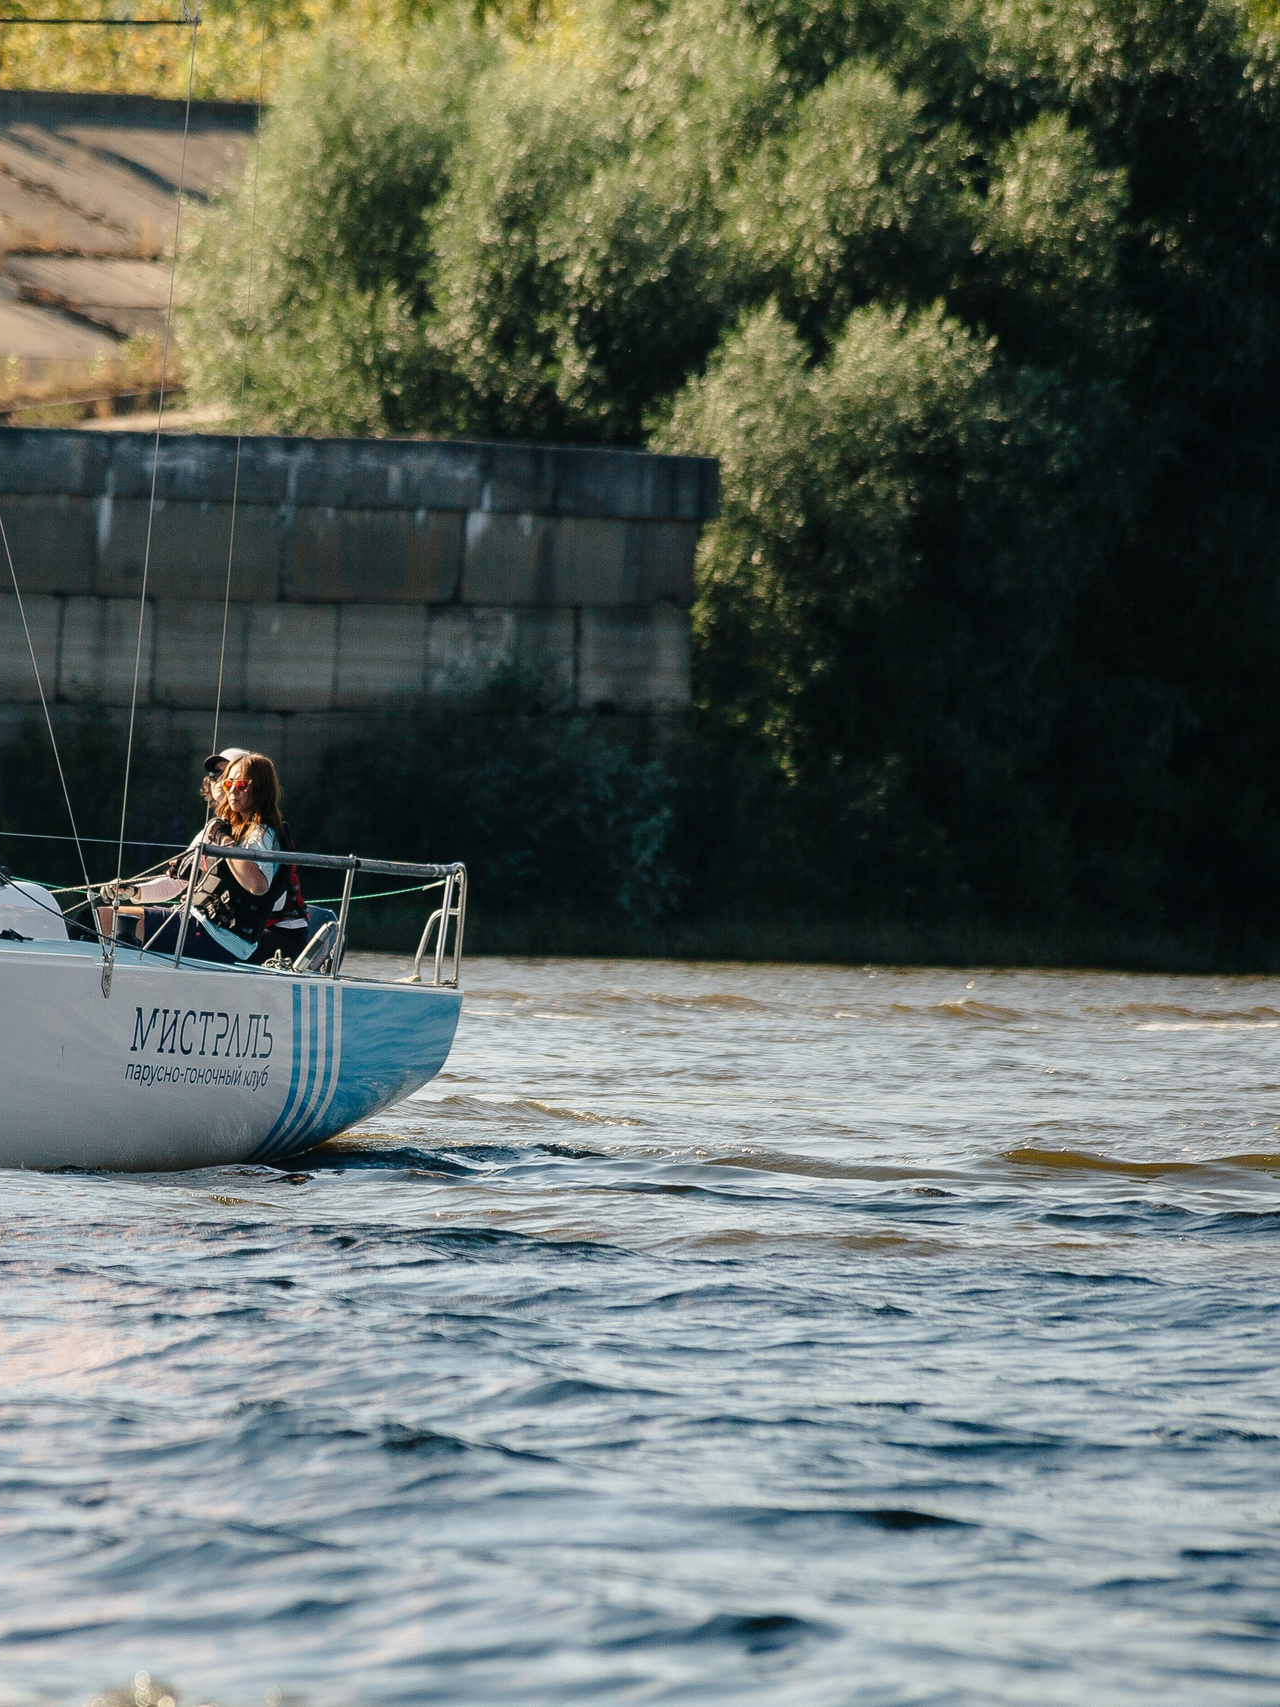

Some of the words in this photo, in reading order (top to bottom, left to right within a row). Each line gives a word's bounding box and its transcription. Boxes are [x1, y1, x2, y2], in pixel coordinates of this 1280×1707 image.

[130, 1006, 273, 1058] МИСТРАЛЬ
[124, 1063, 242, 1087] парусно-гоночный
[242, 1065, 270, 1092] клуб
